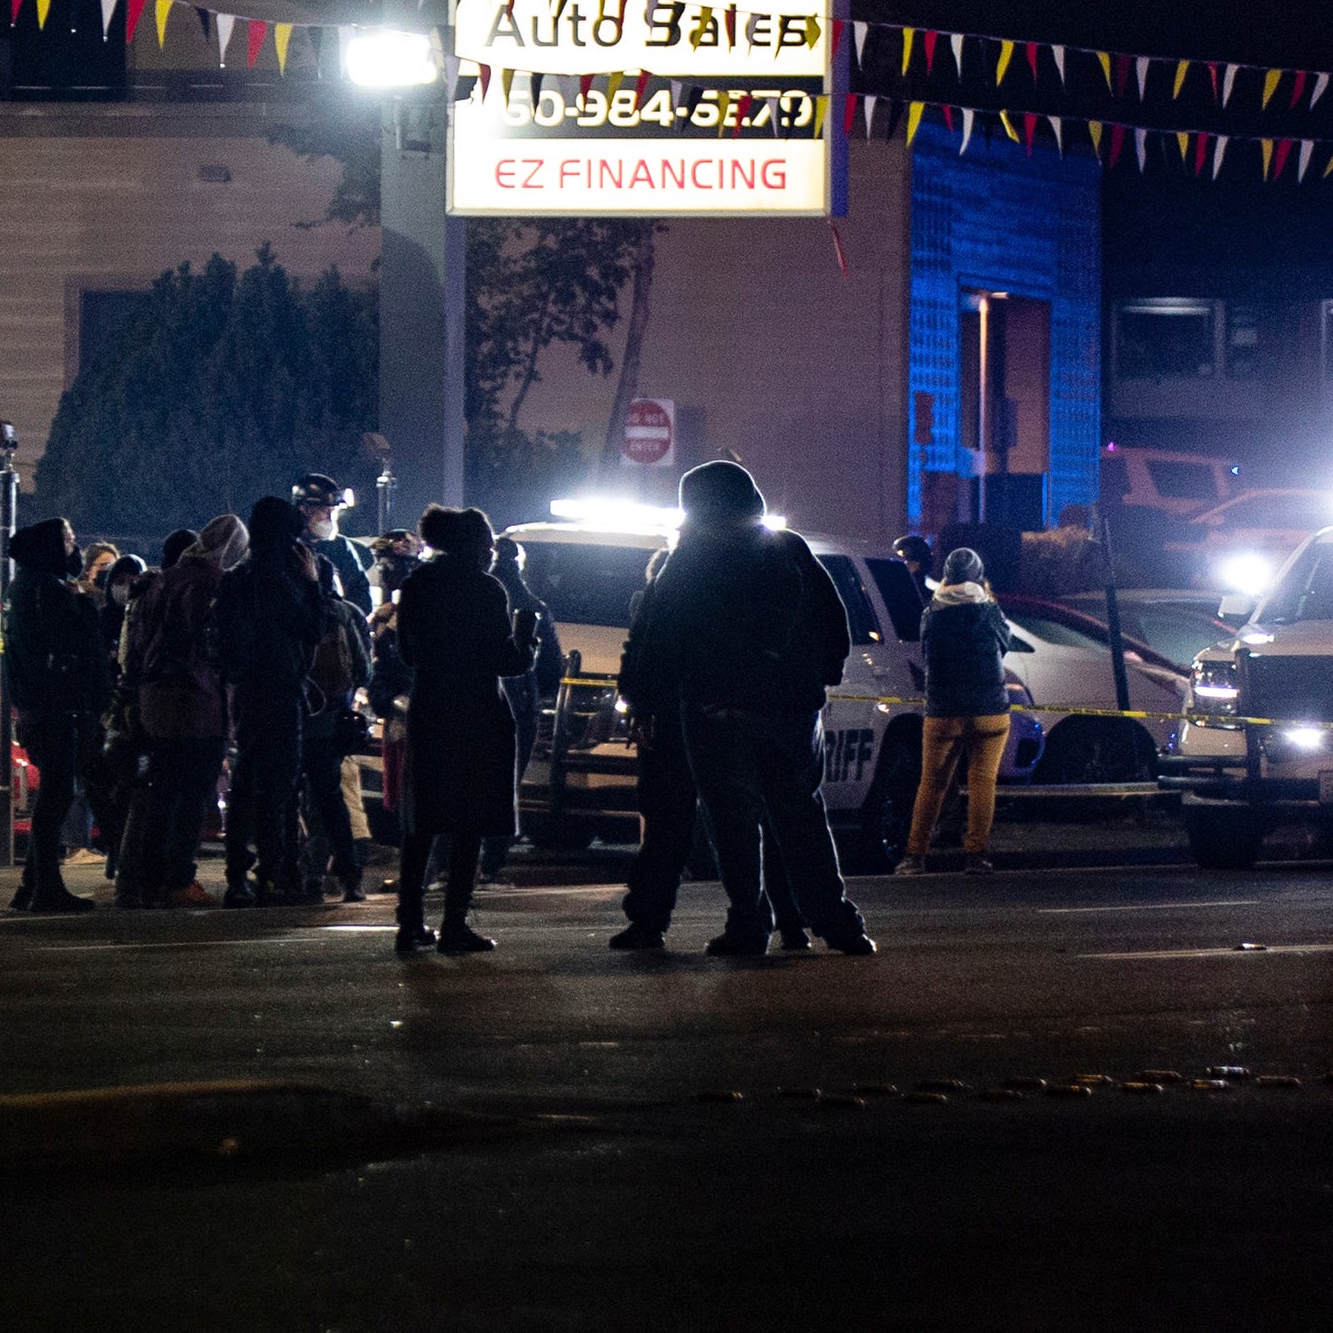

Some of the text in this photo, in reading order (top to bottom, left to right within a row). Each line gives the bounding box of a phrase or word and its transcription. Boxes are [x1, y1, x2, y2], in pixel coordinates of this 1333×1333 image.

[484, 4, 624, 48] Auto
[495, 158, 787, 190] EZ FINANCING
[825, 728, 874, 782] RIFF
